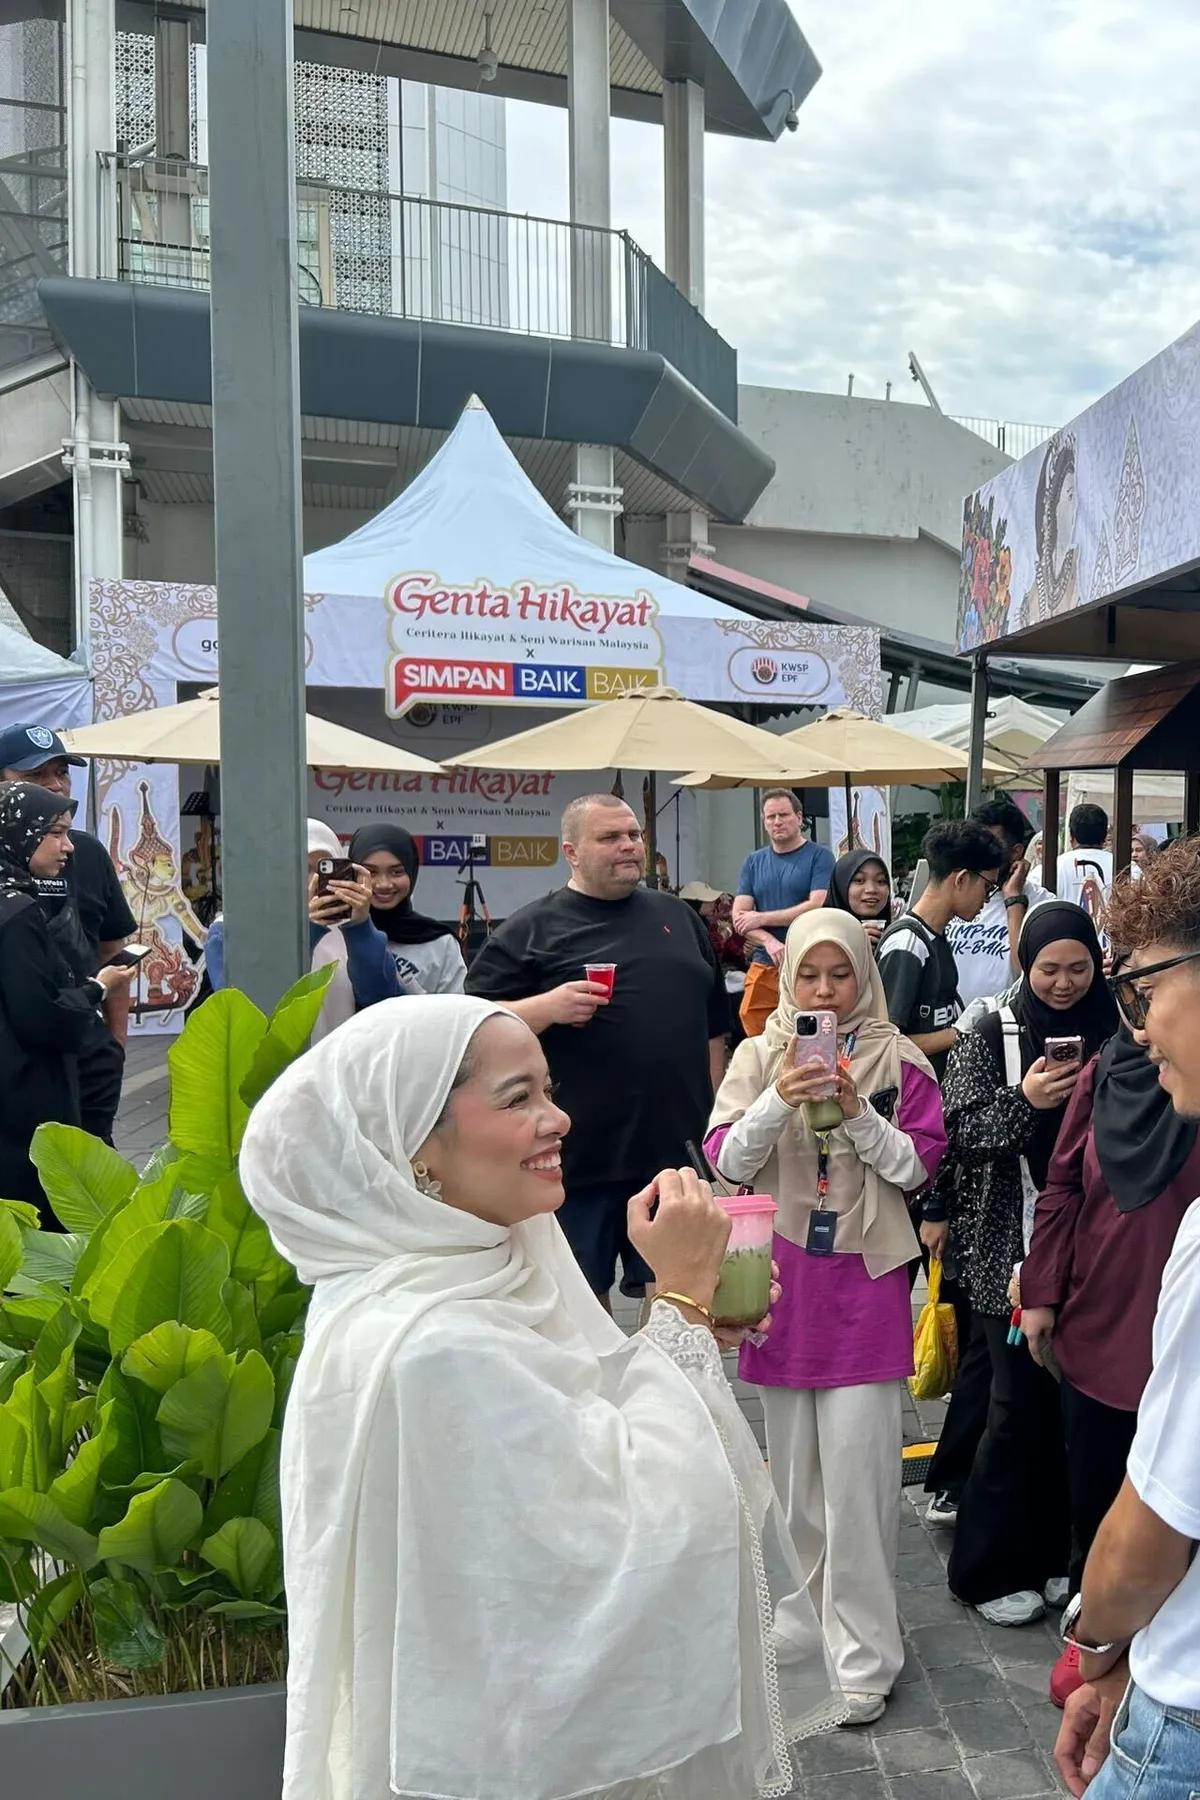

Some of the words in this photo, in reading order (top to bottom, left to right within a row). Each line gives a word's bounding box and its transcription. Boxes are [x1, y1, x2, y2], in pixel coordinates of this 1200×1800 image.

[393, 577, 510, 621] Genta
[517, 586, 652, 634] Hikayat
[406, 627, 456, 640] Ceritera
[461, 630, 505, 644] Hikayat
[509, 633, 517, 643] &
[520, 634, 545, 645] Seni
[549, 635, 596, 648] Warisan
[600, 638, 650, 651] Malaysia
[403, 664, 505, 691] SIMPAN
[521, 668, 581, 693] BAIK
[781, 663, 809, 673] KWSP
[781, 674, 798, 683] EPF
[325, 803, 372, 815] Ceritera
[376, 804, 417, 817] Hikayat
[431, 806, 454, 816] Seni
[457, 806, 501, 817] Warisan
[504, 807, 551, 818] Malaysia
[497, 841, 551, 862] BAIK
